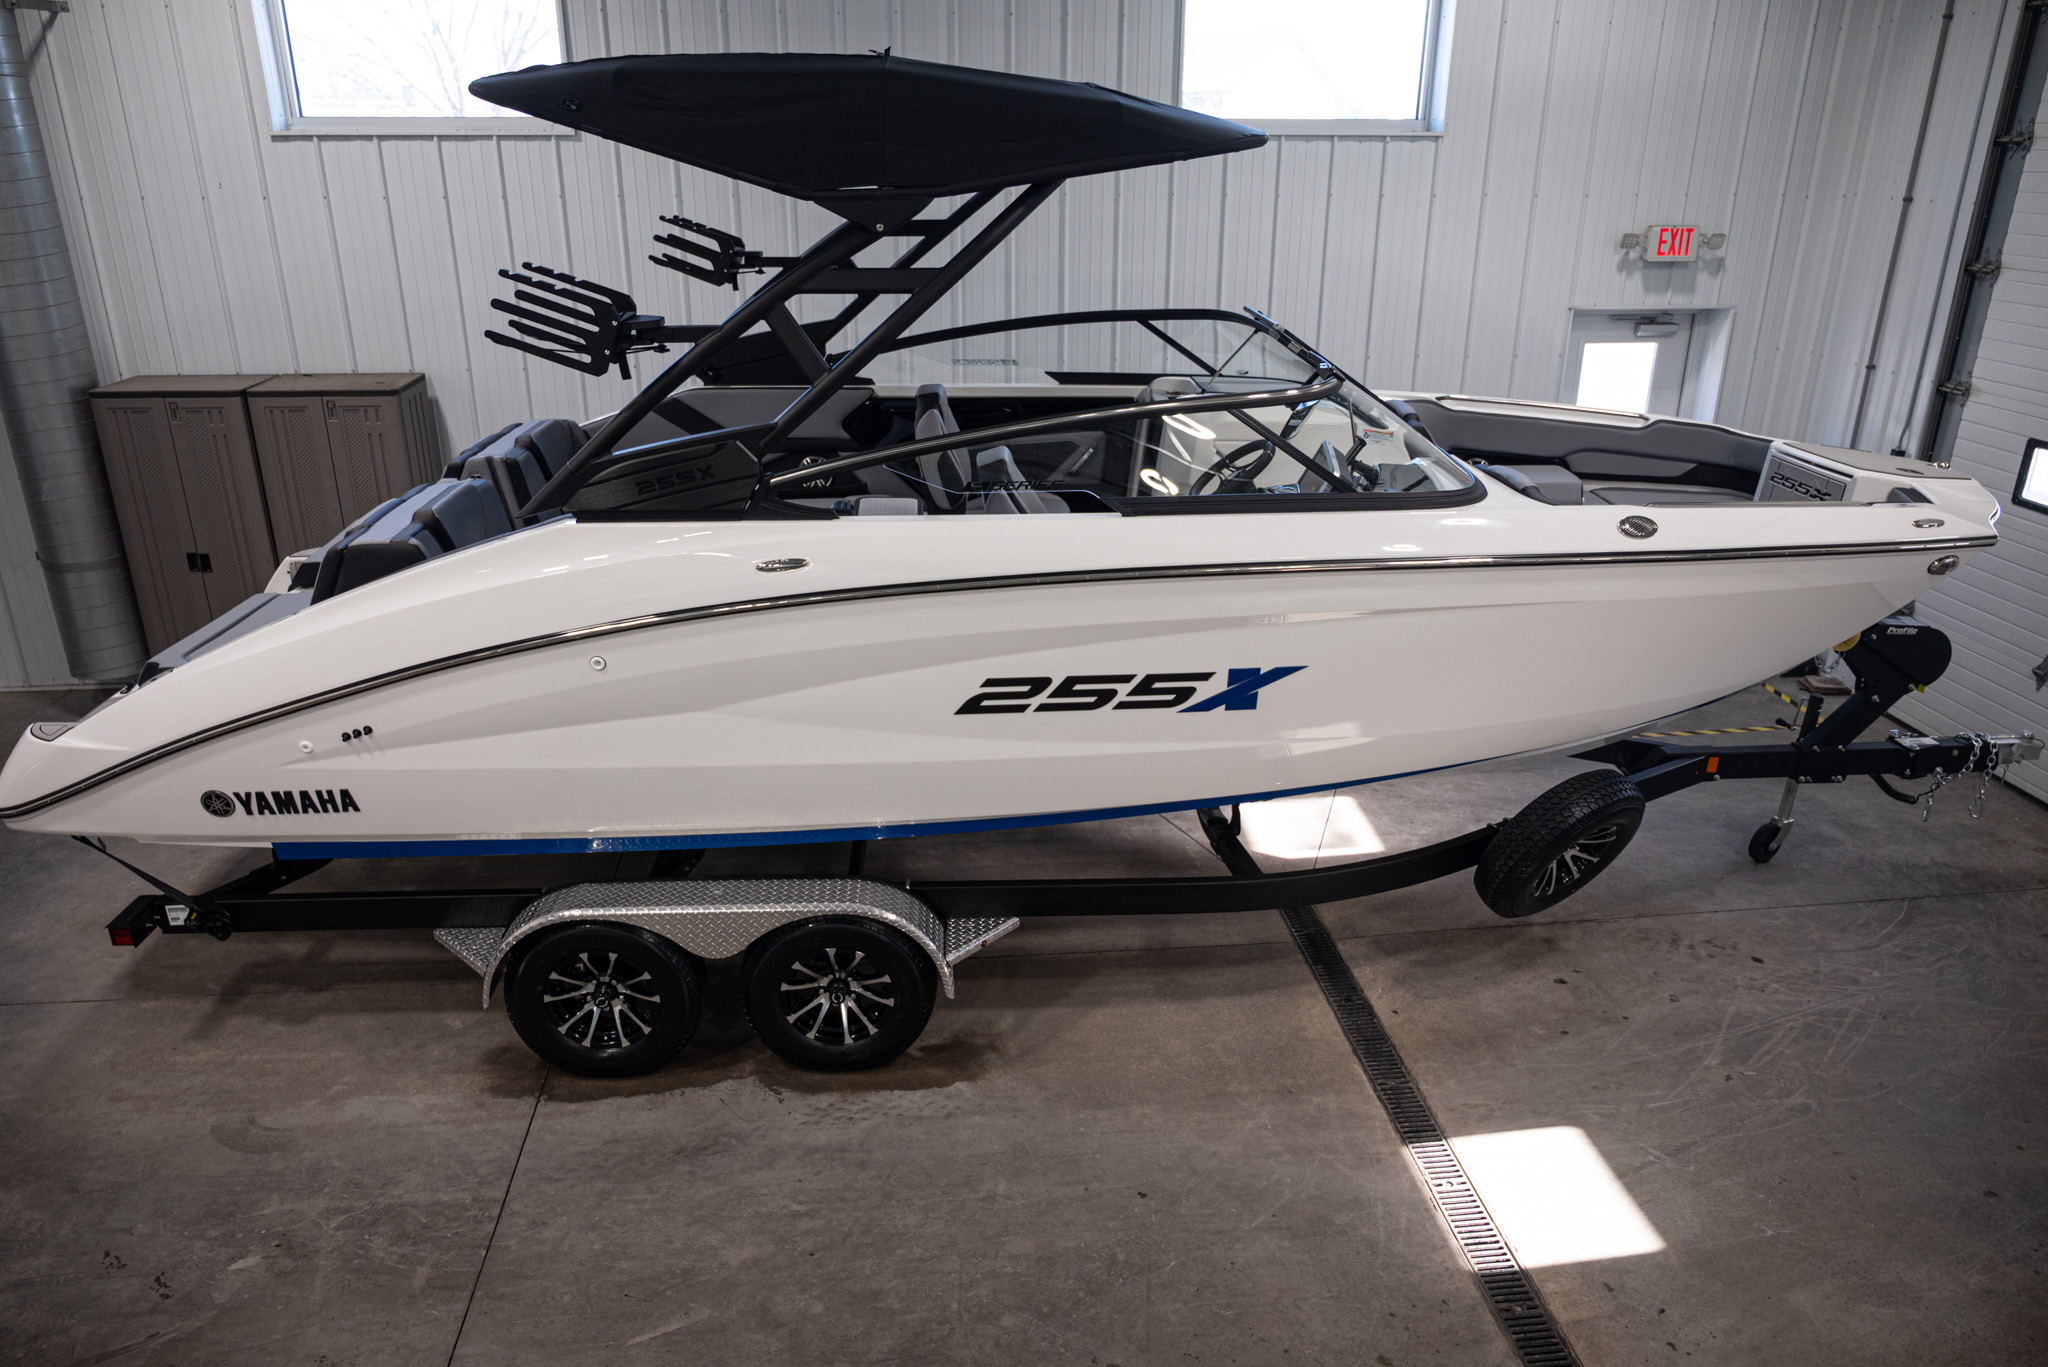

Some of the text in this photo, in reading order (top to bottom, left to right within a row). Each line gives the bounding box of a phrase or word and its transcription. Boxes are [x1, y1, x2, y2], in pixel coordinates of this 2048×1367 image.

[1656, 227, 1695, 257] EXIT
[634, 464, 715, 495] 255X
[988, 479, 1065, 492] SERIES
[1770, 472, 1832, 502] 255X
[1886, 626, 1919, 636] Profile
[953, 665, 1310, 715] 255X
[232, 789, 361, 816] YAMAHA
